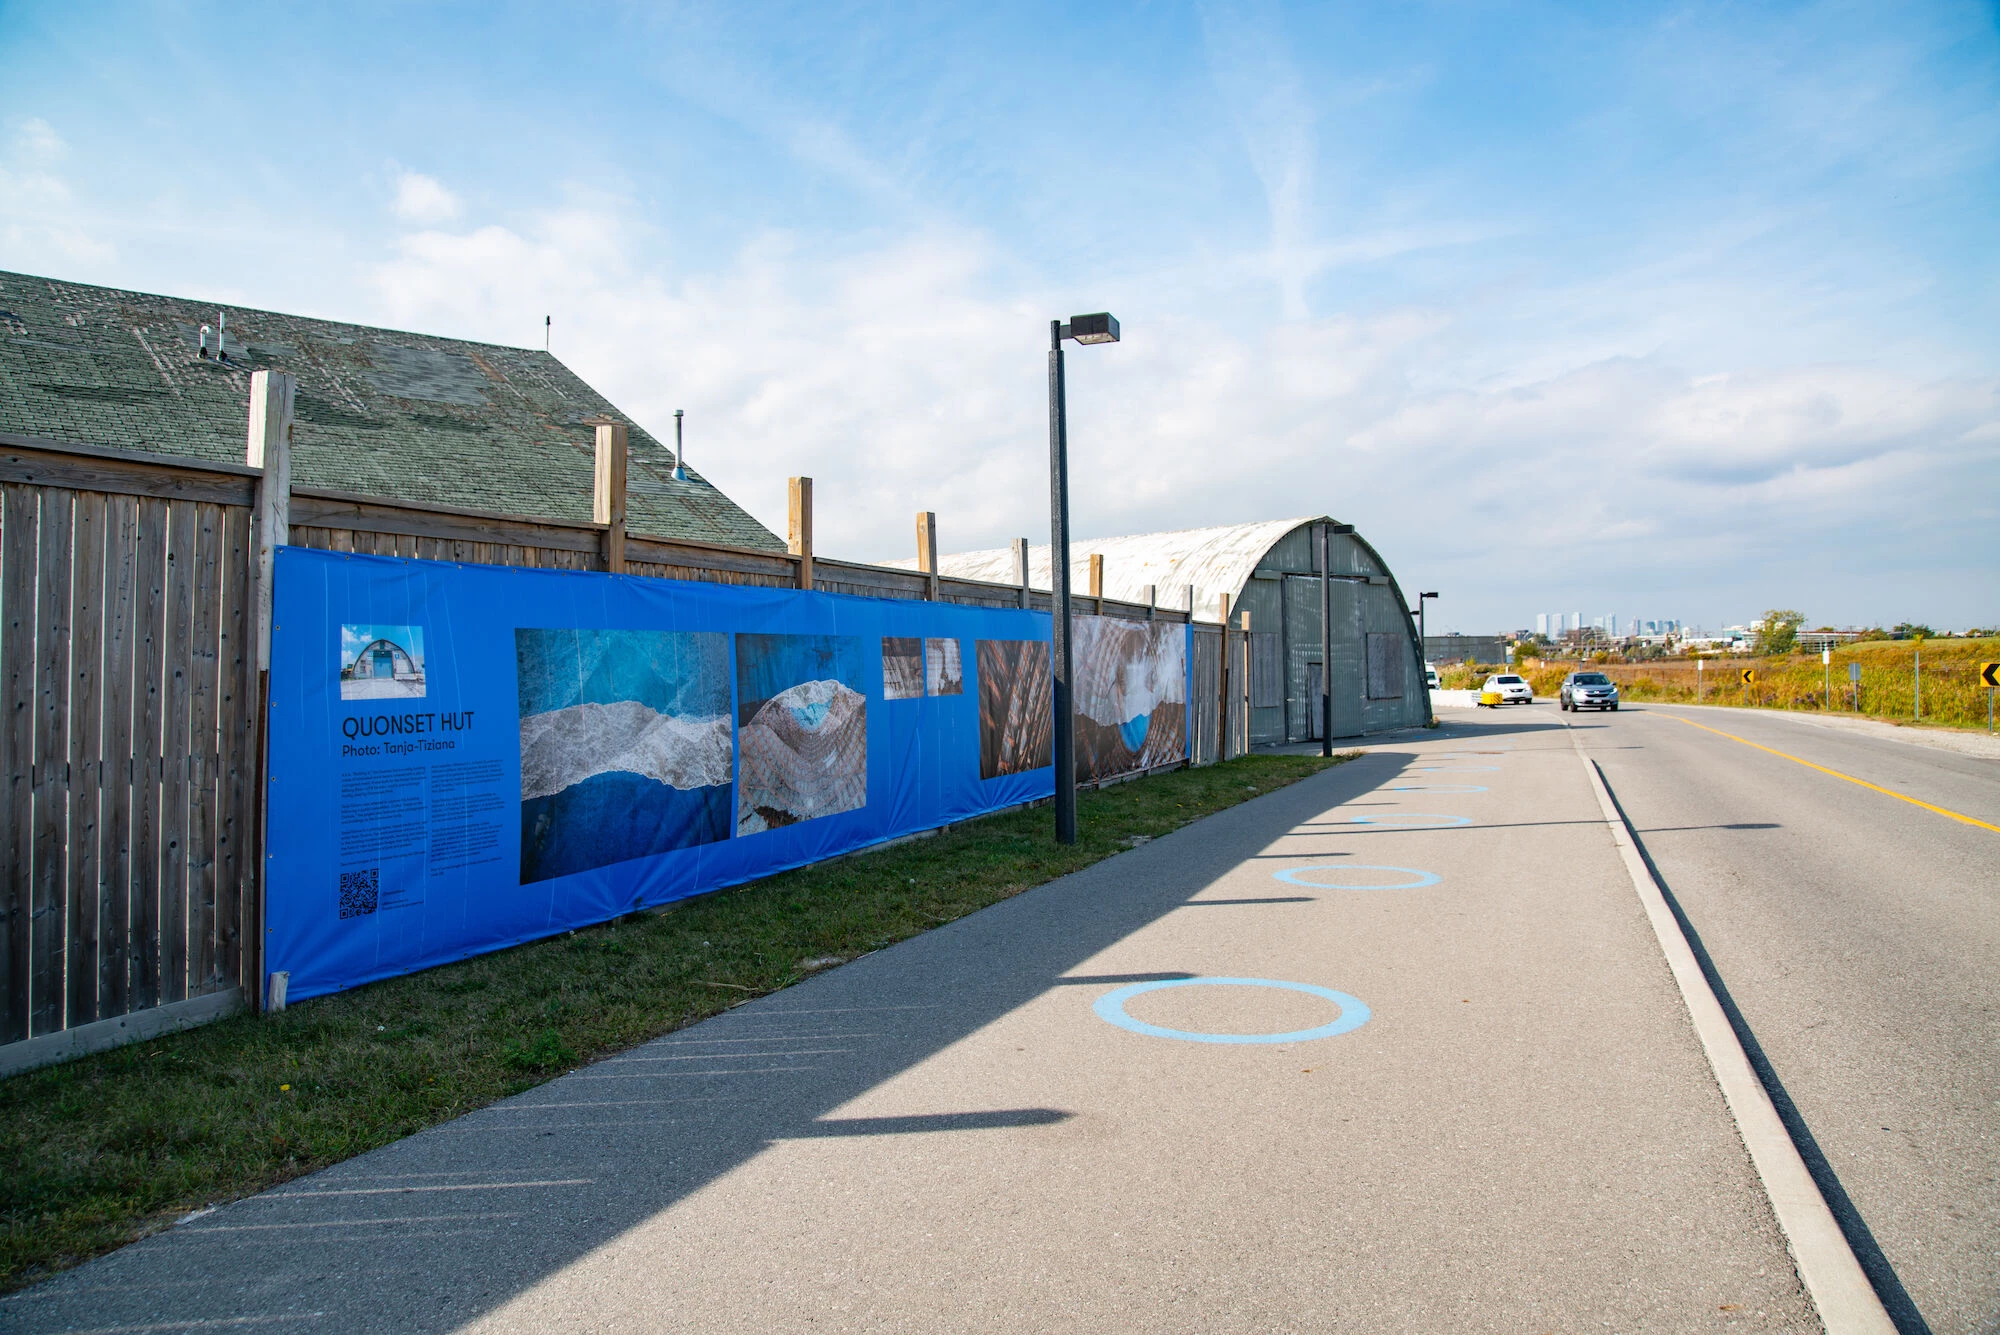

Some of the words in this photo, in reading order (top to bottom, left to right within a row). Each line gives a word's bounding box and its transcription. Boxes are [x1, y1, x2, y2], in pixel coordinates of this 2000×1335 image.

[342, 713, 436, 740] QUONSET
[441, 711, 475, 732] HUT
[342, 744, 381, 757] Photo:
[383, 739, 456, 756] Tanja-Tiziana
